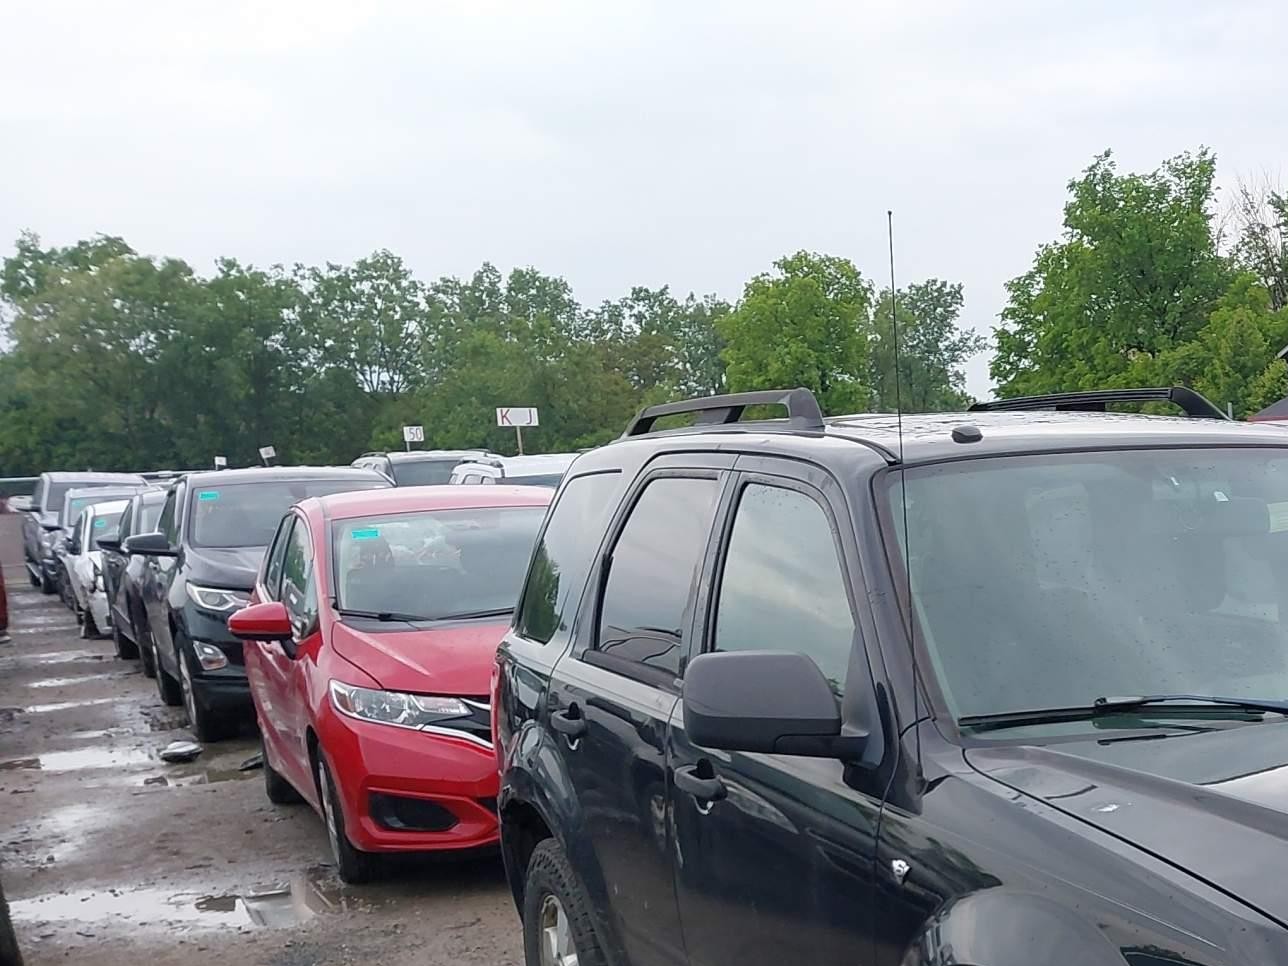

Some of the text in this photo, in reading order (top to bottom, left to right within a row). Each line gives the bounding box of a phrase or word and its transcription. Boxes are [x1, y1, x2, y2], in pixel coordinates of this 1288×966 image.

[500, 408, 533, 425] K J
[408, 428, 422, 441] 50
